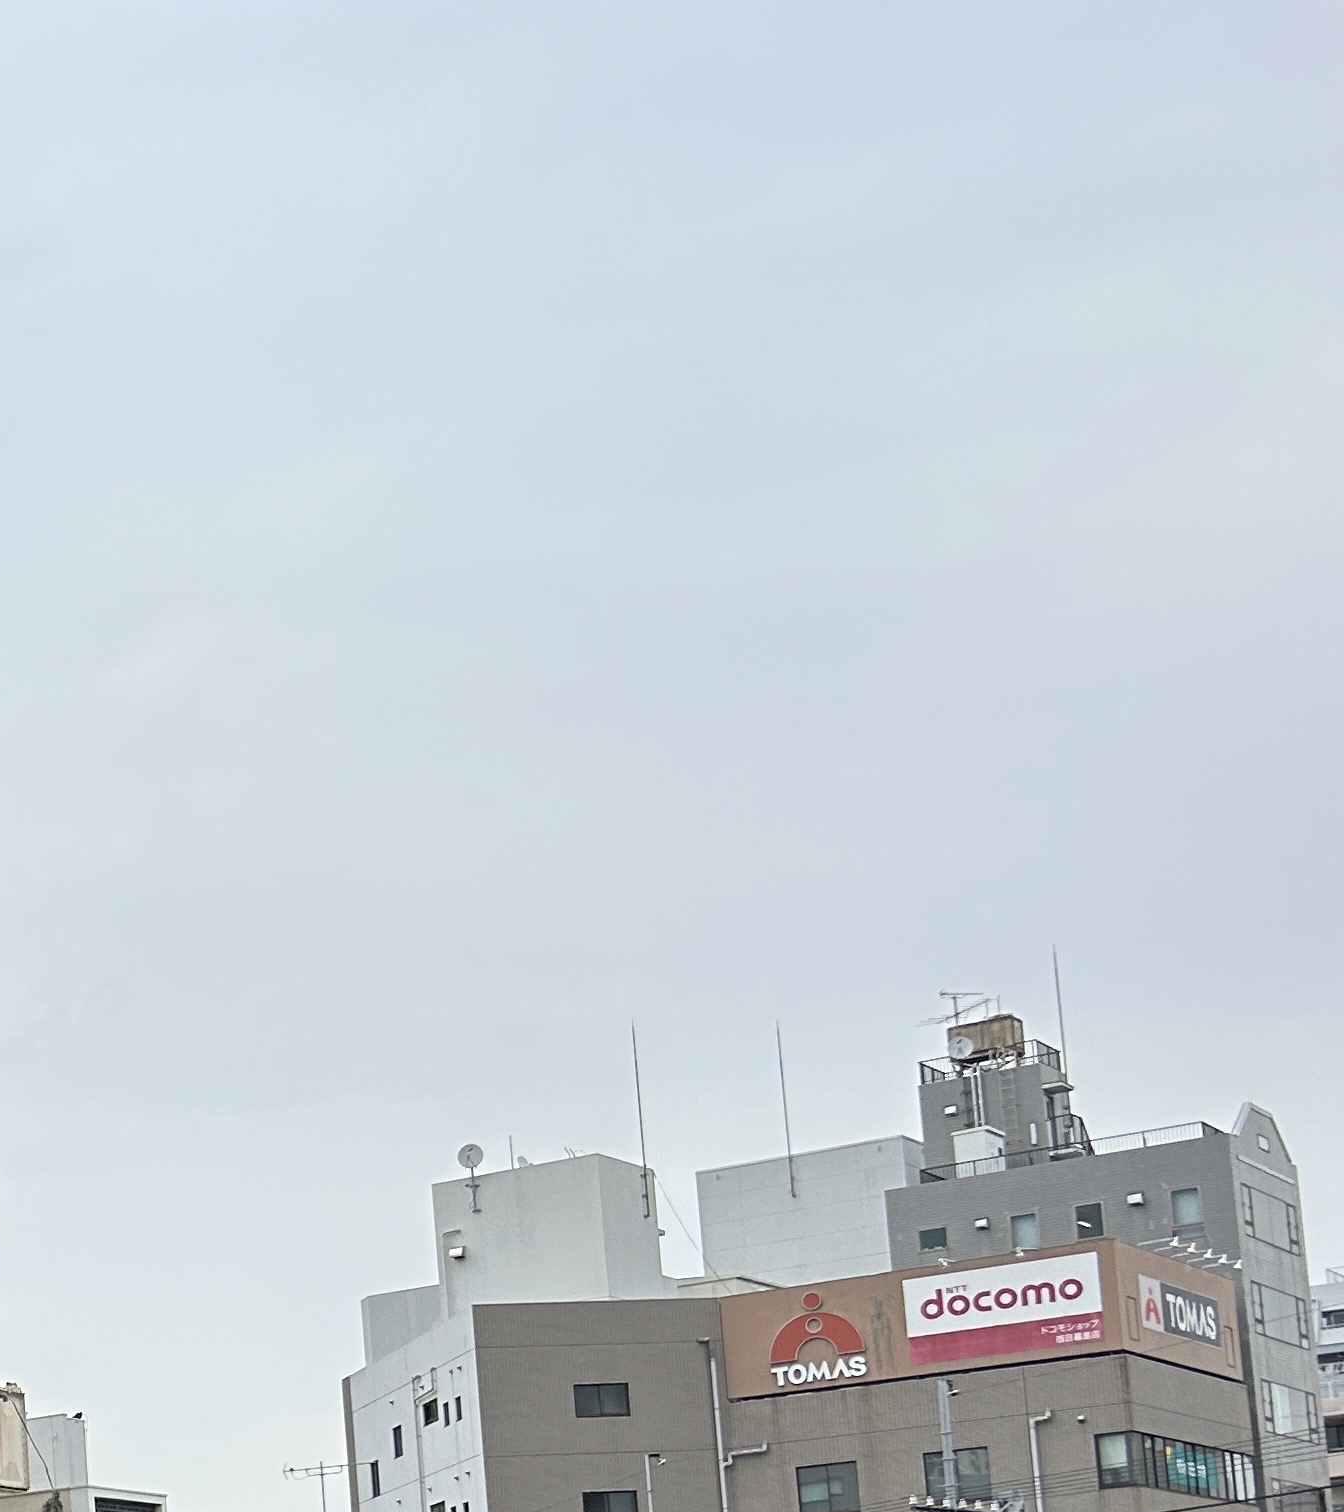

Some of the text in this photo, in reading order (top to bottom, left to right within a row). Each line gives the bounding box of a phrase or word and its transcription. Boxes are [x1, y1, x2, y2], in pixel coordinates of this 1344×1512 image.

[920, 1277, 1083, 1320] docomo
[1165, 1293, 1217, 1341] TOMAS
[771, 1356, 867, 1387] TOMAS
